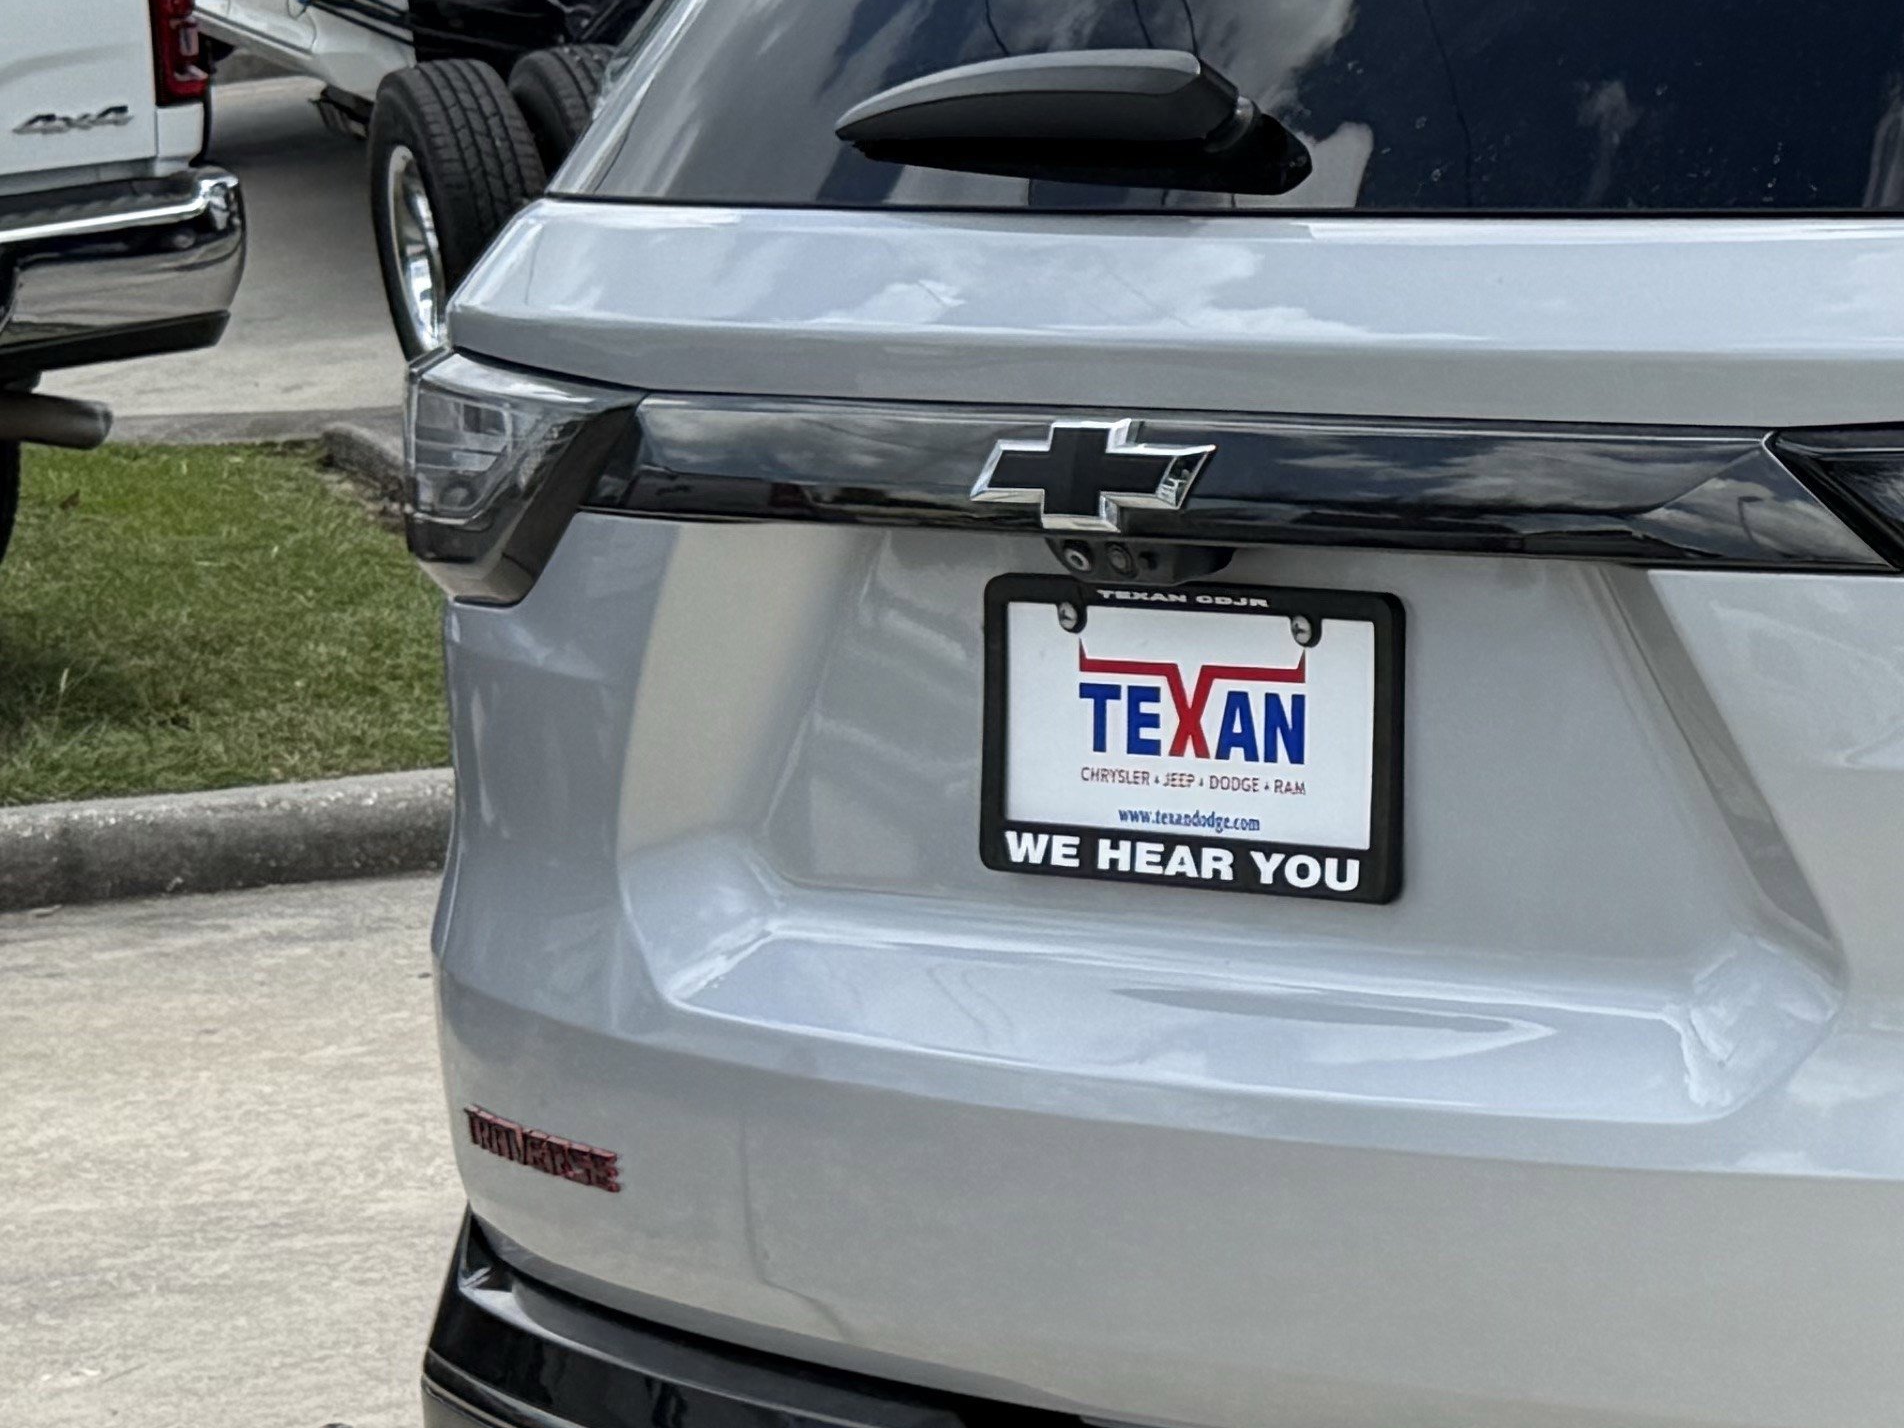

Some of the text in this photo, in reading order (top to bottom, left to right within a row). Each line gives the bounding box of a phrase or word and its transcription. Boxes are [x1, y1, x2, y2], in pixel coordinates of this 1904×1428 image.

[1097, 588, 1188, 603] TEXAN
[1079, 652, 1306, 765] TEXAN
[1081, 766, 1307, 796] CHRYSLER JEEP DODGE RAM
[1118, 807, 1261, 834] www.texandodge.com
[1005, 831, 1361, 893] WE HEAR YOU
